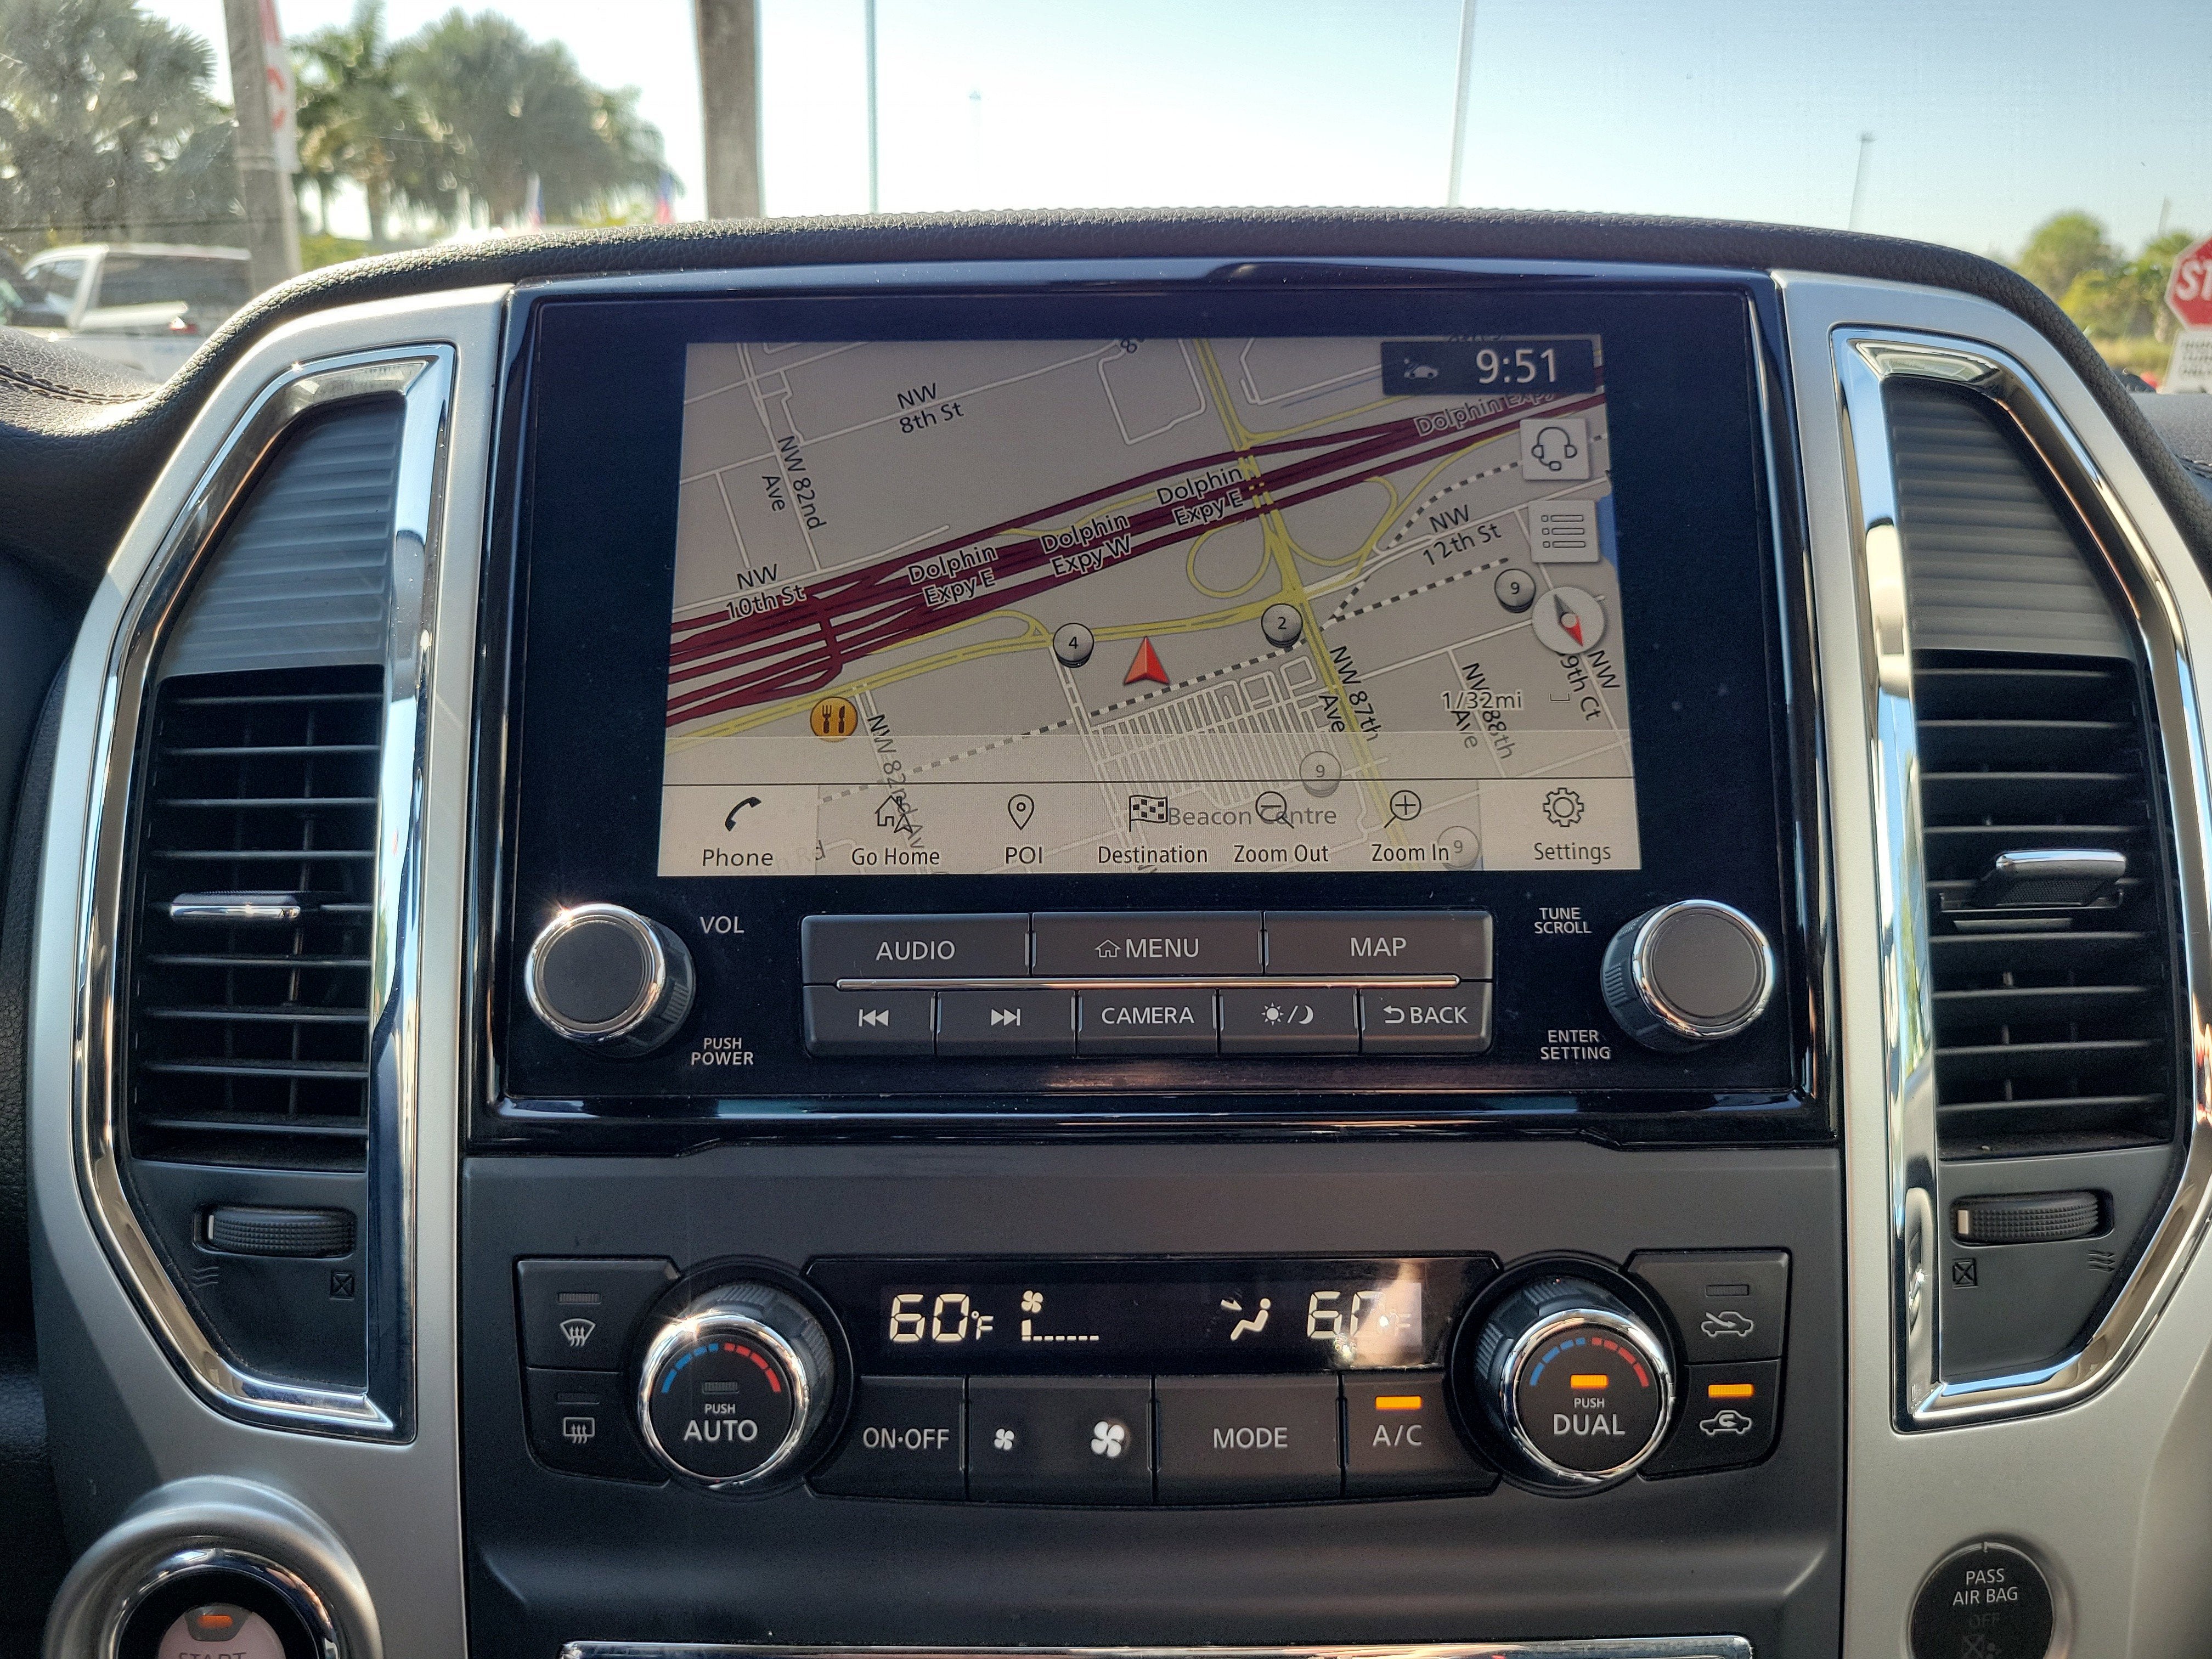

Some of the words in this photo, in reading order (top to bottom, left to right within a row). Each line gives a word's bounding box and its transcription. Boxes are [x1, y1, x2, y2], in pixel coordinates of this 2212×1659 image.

[1476, 349, 1556, 384] 9:51
[897, 383, 937, 409] NW
[901, 410, 937, 434] 8th
[941, 401, 964, 421] St
[1414, 396, 1500, 436] Dolphin
[778, 436, 806, 472] NW
[793, 477, 827, 530] 82nd
[1156, 466, 1243, 505] Dolphin
[762, 476, 786, 512] Ave
[1173, 501, 1224, 527] Expy
[1229, 490, 1244, 508] E
[1430, 505, 1470, 533] NW
[1042, 513, 1129, 553] Dolphin
[1423, 530, 1476, 566] 12th
[1479, 523, 1502, 545] St
[909, 546, 996, 583] Dolphin
[1052, 548, 1103, 577] Expy
[1107, 535, 1132, 557] W
[737, 563, 777, 590] NW
[924, 576, 976, 605] Expy
[981, 570, 995, 588] E
[1511, 582, 1520, 595] 9
[726, 594, 777, 619] 10th
[782, 585, 805, 604] St
[1277, 616, 1286, 630] 2
[1068, 636, 1079, 650] 4
[1587, 650, 1621, 689] NW
[1330, 646, 1362, 684] NW
[1349, 691, 1381, 741] 87th
[1556, 651, 1588, 692] 9th
[1579, 696, 1601, 721] Ct
[1442, 691, 1522, 709] 1/32mi
[1318, 695, 1344, 733] Ave
[1451, 710, 1478, 748] Ave
[1483, 710, 1515, 759] 88th
[867, 714, 896, 753] NW
[883, 760, 918, 816] 82nd
[1316, 765, 1325, 778] 9
[1169, 807, 1251, 825] Beacon
[703, 848, 773, 866] Phone
[851, 848, 877, 866] Go
[885, 848, 940, 866] Home
[1006, 846, 1042, 864] POI
[1098, 845, 1207, 864] Destination
[1234, 845, 1288, 863] Zoom
[1295, 844, 1329, 863] Out
[1372, 844, 1425, 862] Zoom
[1432, 844, 1449, 861] In
[1454, 840, 1463, 854] 9
[1534, 843, 1611, 864] Settings
[1539, 907, 1581, 919] TUNE
[700, 916, 744, 934] VOL
[1534, 921, 1591, 934] SCROLL
[876, 940, 956, 961] AUDIO
[1126, 938, 1199, 958] MENU
[1350, 937, 1407, 957] MAP
[1101, 1006, 1194, 1024] CAMERA
[1410, 1006, 1468, 1024] BACK
[703, 1037, 742, 1049] PUSH
[1548, 1029, 1599, 1042] ENTER
[691, 1051, 754, 1065] POWER
[1541, 1046, 1611, 1060] SETTING
[704, 1403, 736, 1414] PUSH
[1574, 1397, 1605, 1409] PUSH
[684, 1419, 758, 1442] AUTO
[1553, 1413, 1626, 1436] DUAL
[1214, 1427, 1288, 1449] MODE
[1373, 1424, 1422, 1447] A/C
[1966, 1568, 2005, 1585] PASS
[1953, 1589, 1979, 1606] AIR
[1986, 1586, 2018, 1603] BAG
